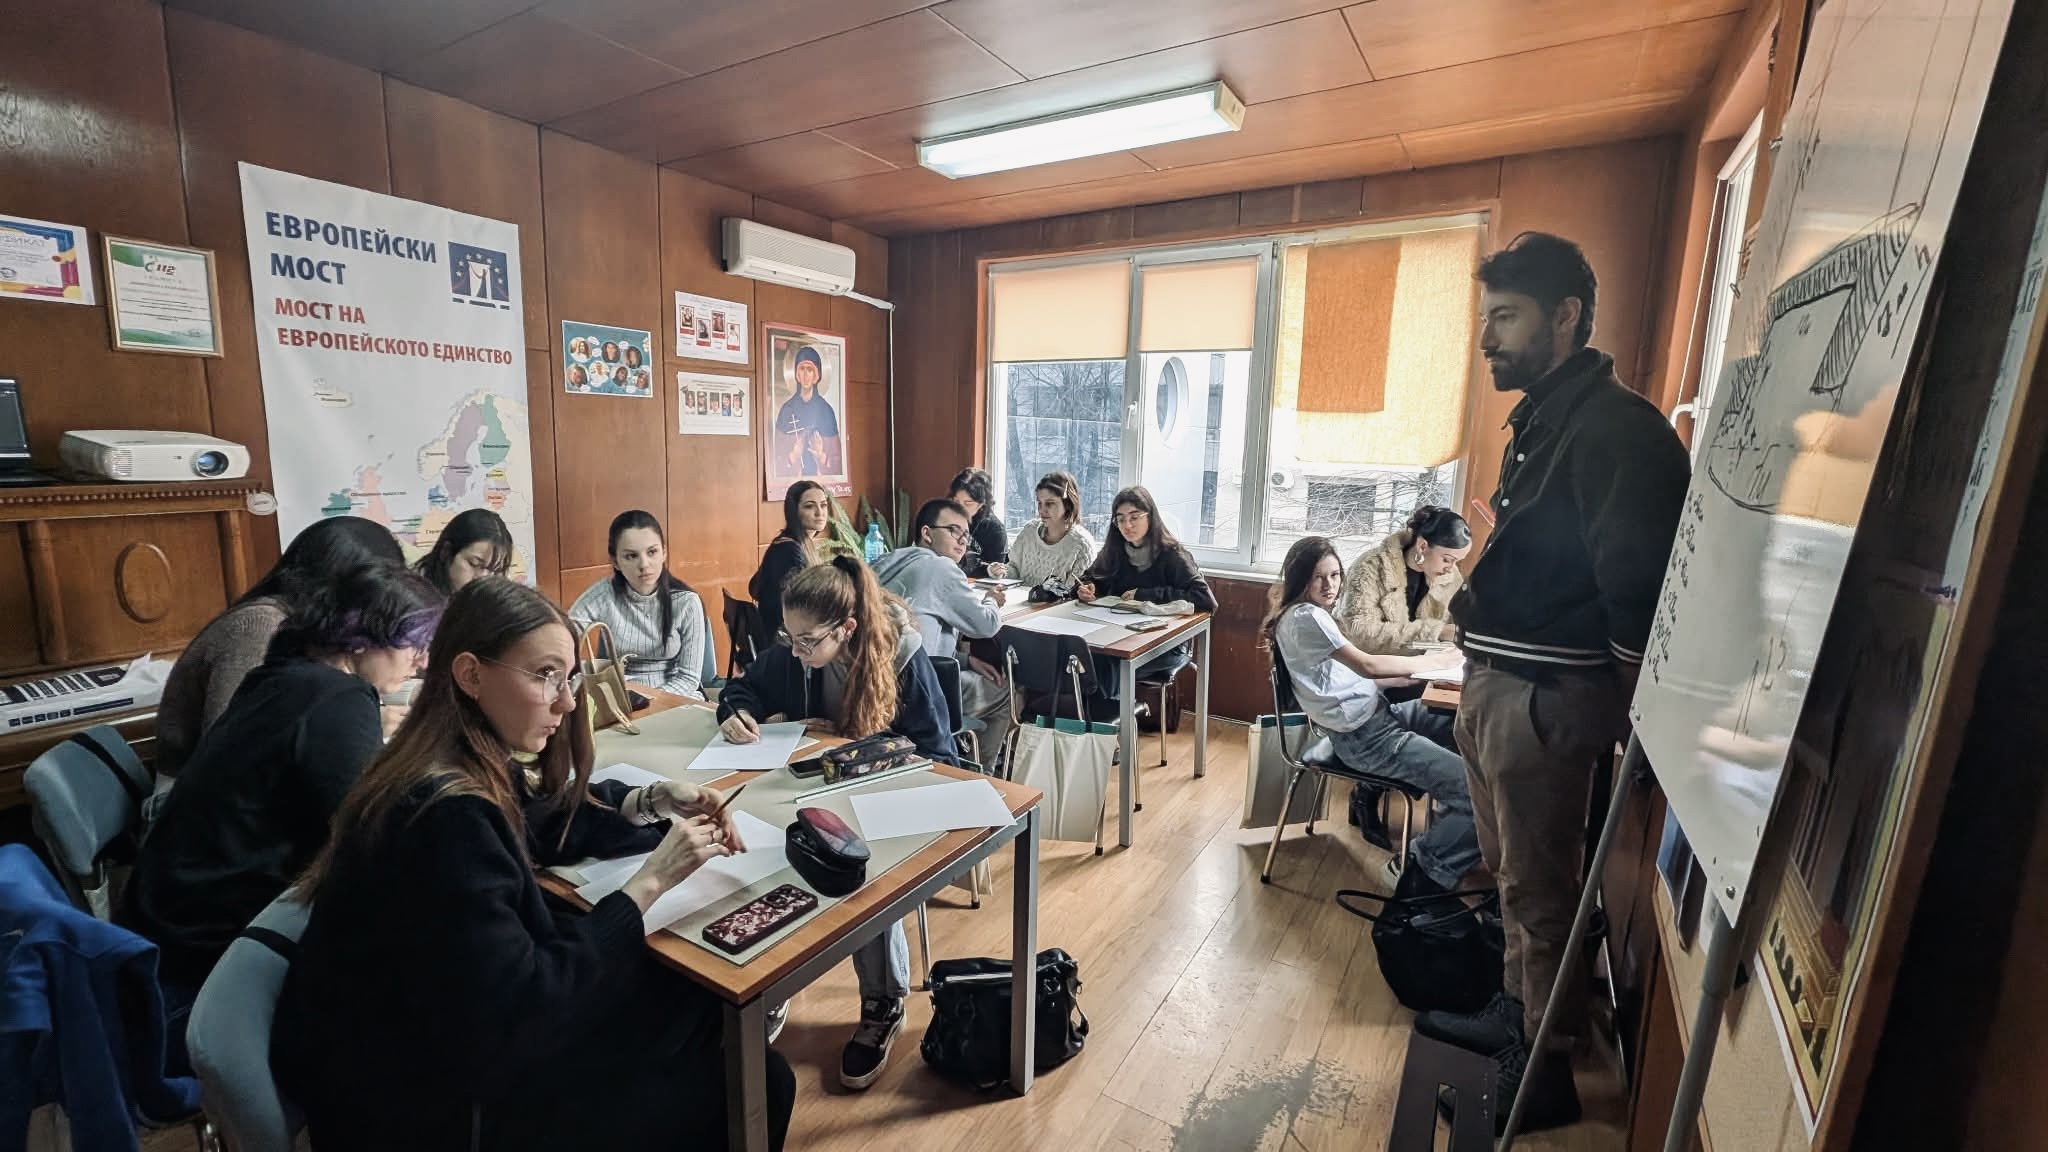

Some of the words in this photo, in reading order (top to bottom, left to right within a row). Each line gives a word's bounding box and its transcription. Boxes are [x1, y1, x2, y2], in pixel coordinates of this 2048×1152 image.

[265, 211, 437, 264] ЕВРОПЕЙСКИ
[270, 252, 346, 285] МОСТ
[275, 297, 333, 321] МОСТ
[338, 305, 366, 324] НА
[277, 327, 429, 358] ЕВРОПЕЙСКОТО
[433, 342, 512, 365] ЕДИНСТВО
